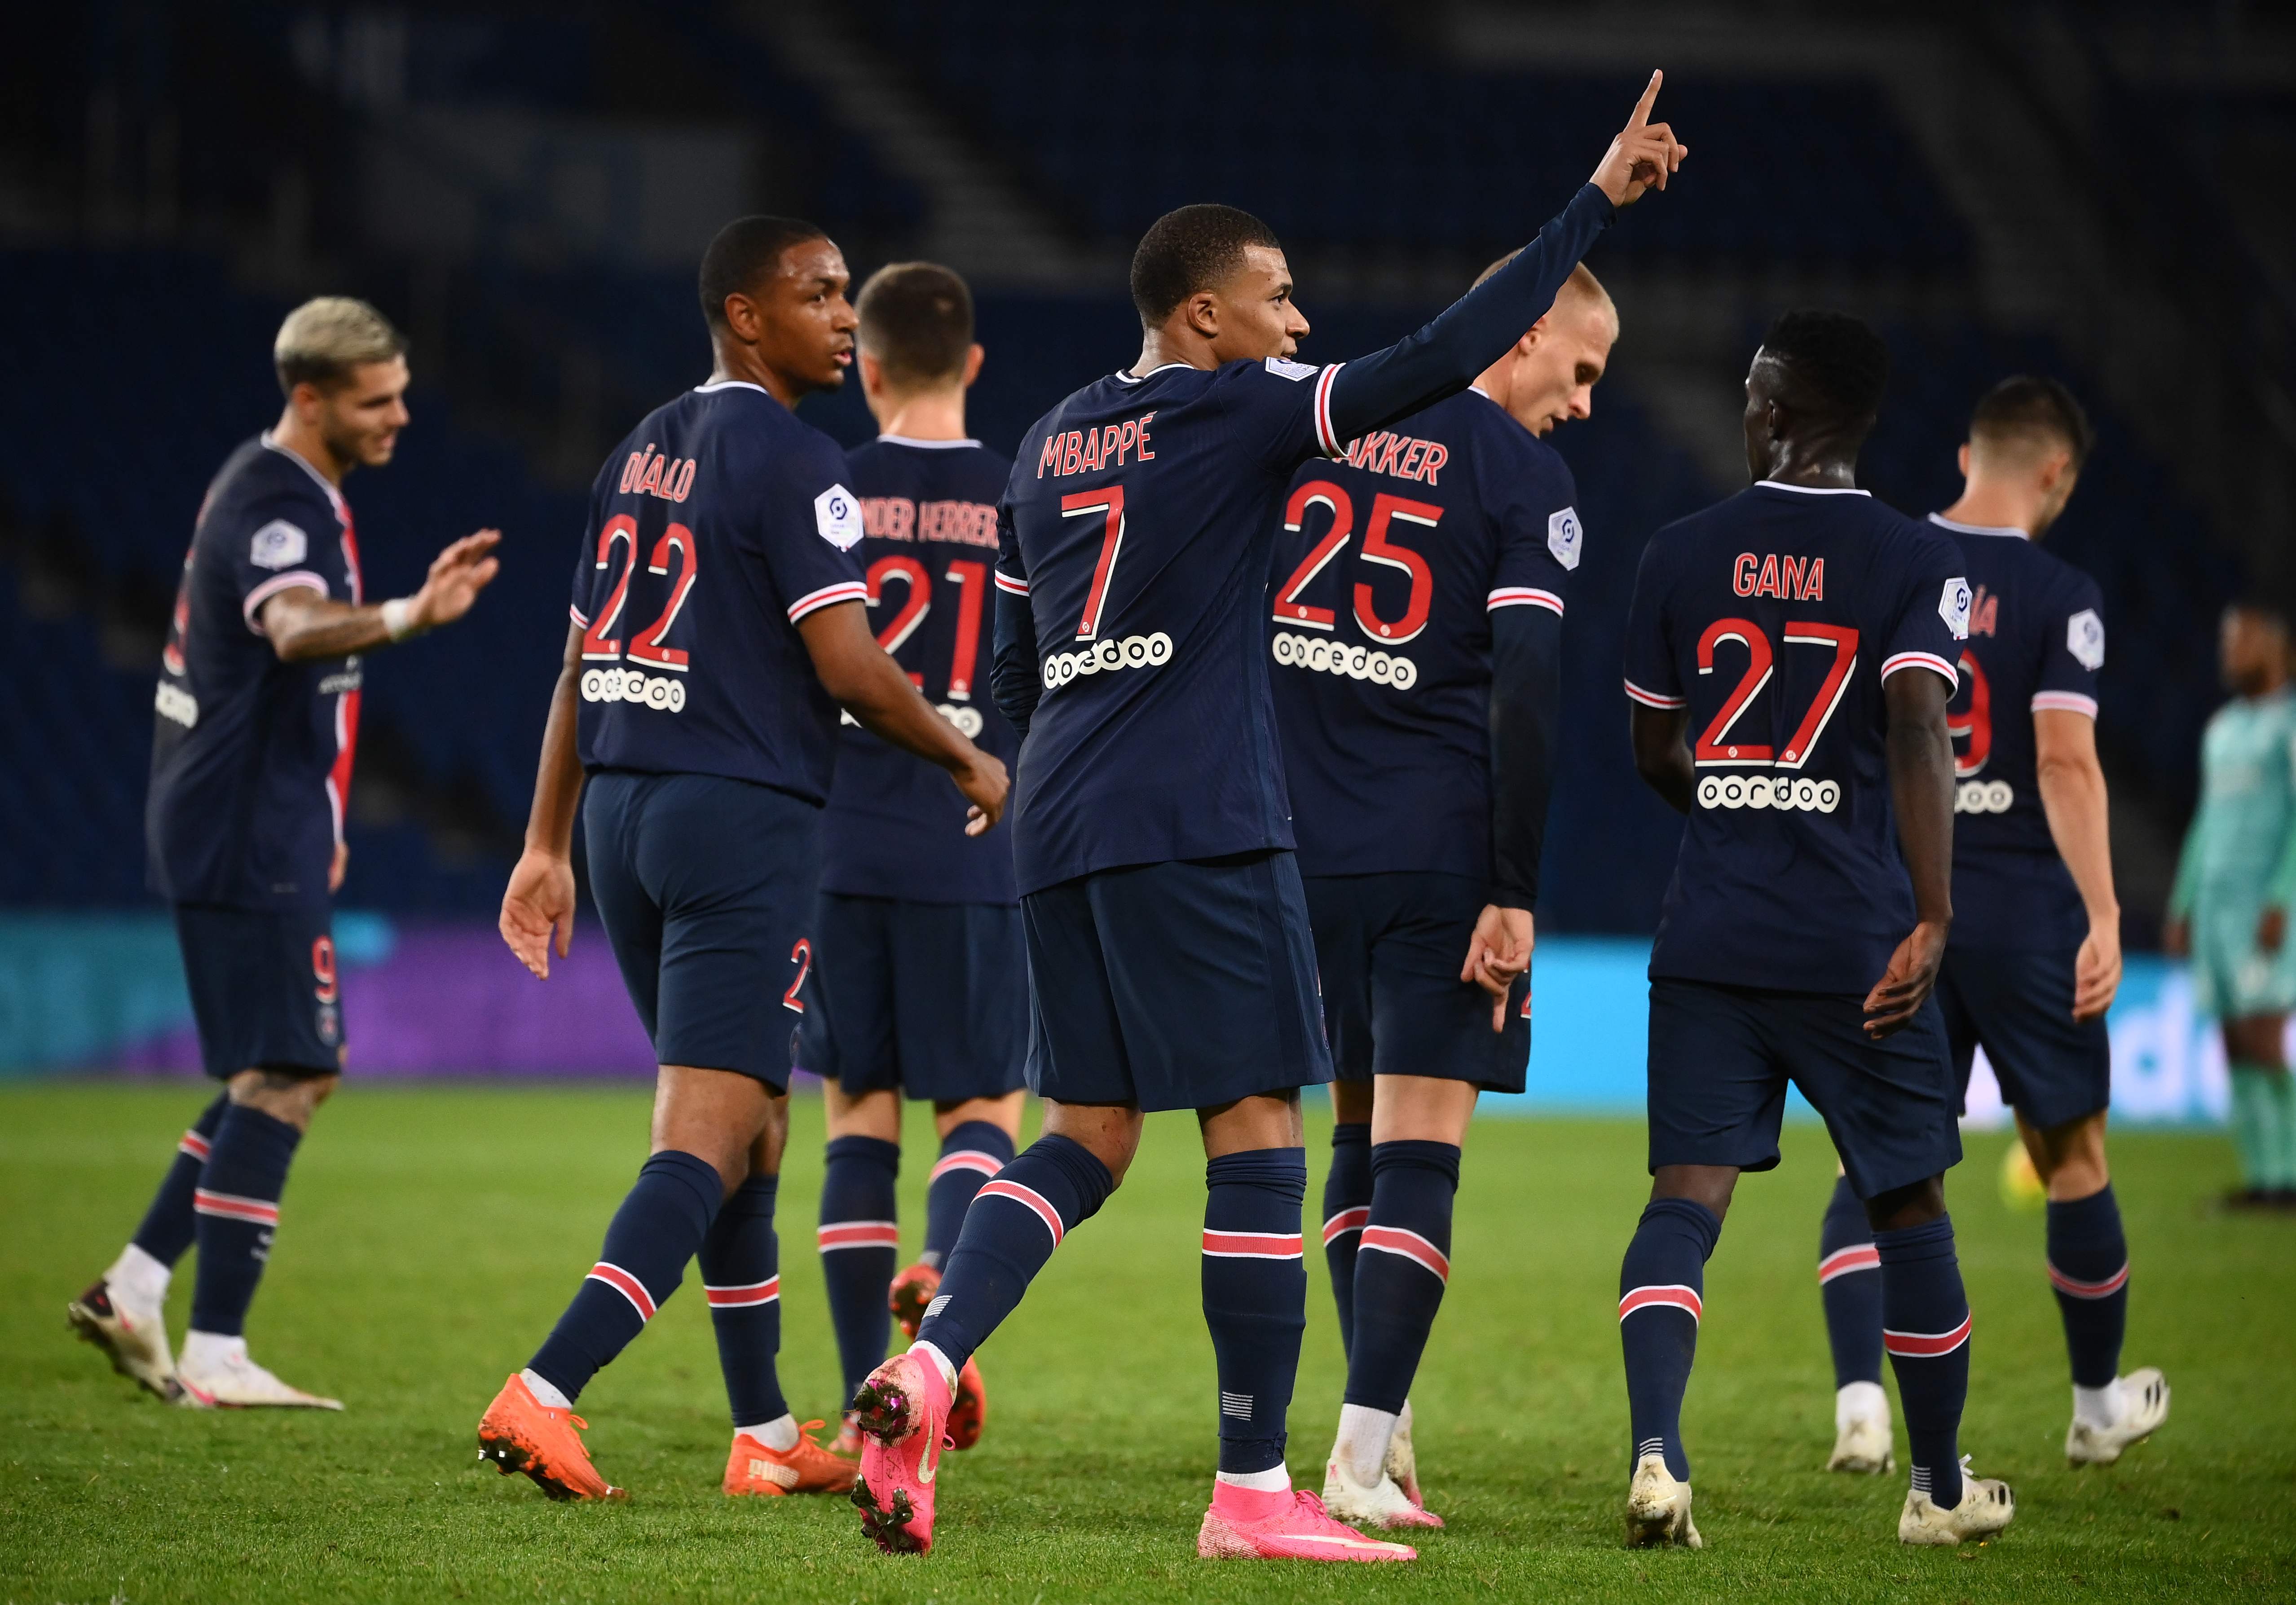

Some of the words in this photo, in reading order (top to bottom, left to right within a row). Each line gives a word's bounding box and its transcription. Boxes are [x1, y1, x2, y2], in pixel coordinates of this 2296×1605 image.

[1037, 411, 1158, 479] MBAPPÉ
[1332, 431, 1449, 486] AKKER
[918, 499, 1000, 550] HERRER
[582, 514, 697, 672] 22
[1061, 485, 1125, 641] 7
[1272, 480, 1445, 645] 25
[1733, 552, 1824, 601] GANA
[866, 555, 986, 701] 21
[1044, 633, 1172, 688] ooedoo
[1273, 632, 1417, 690] ooredoo
[1695, 618, 1859, 769] 27
[1946, 647, 1992, 778] 9
[312, 935, 338, 1004] 9
